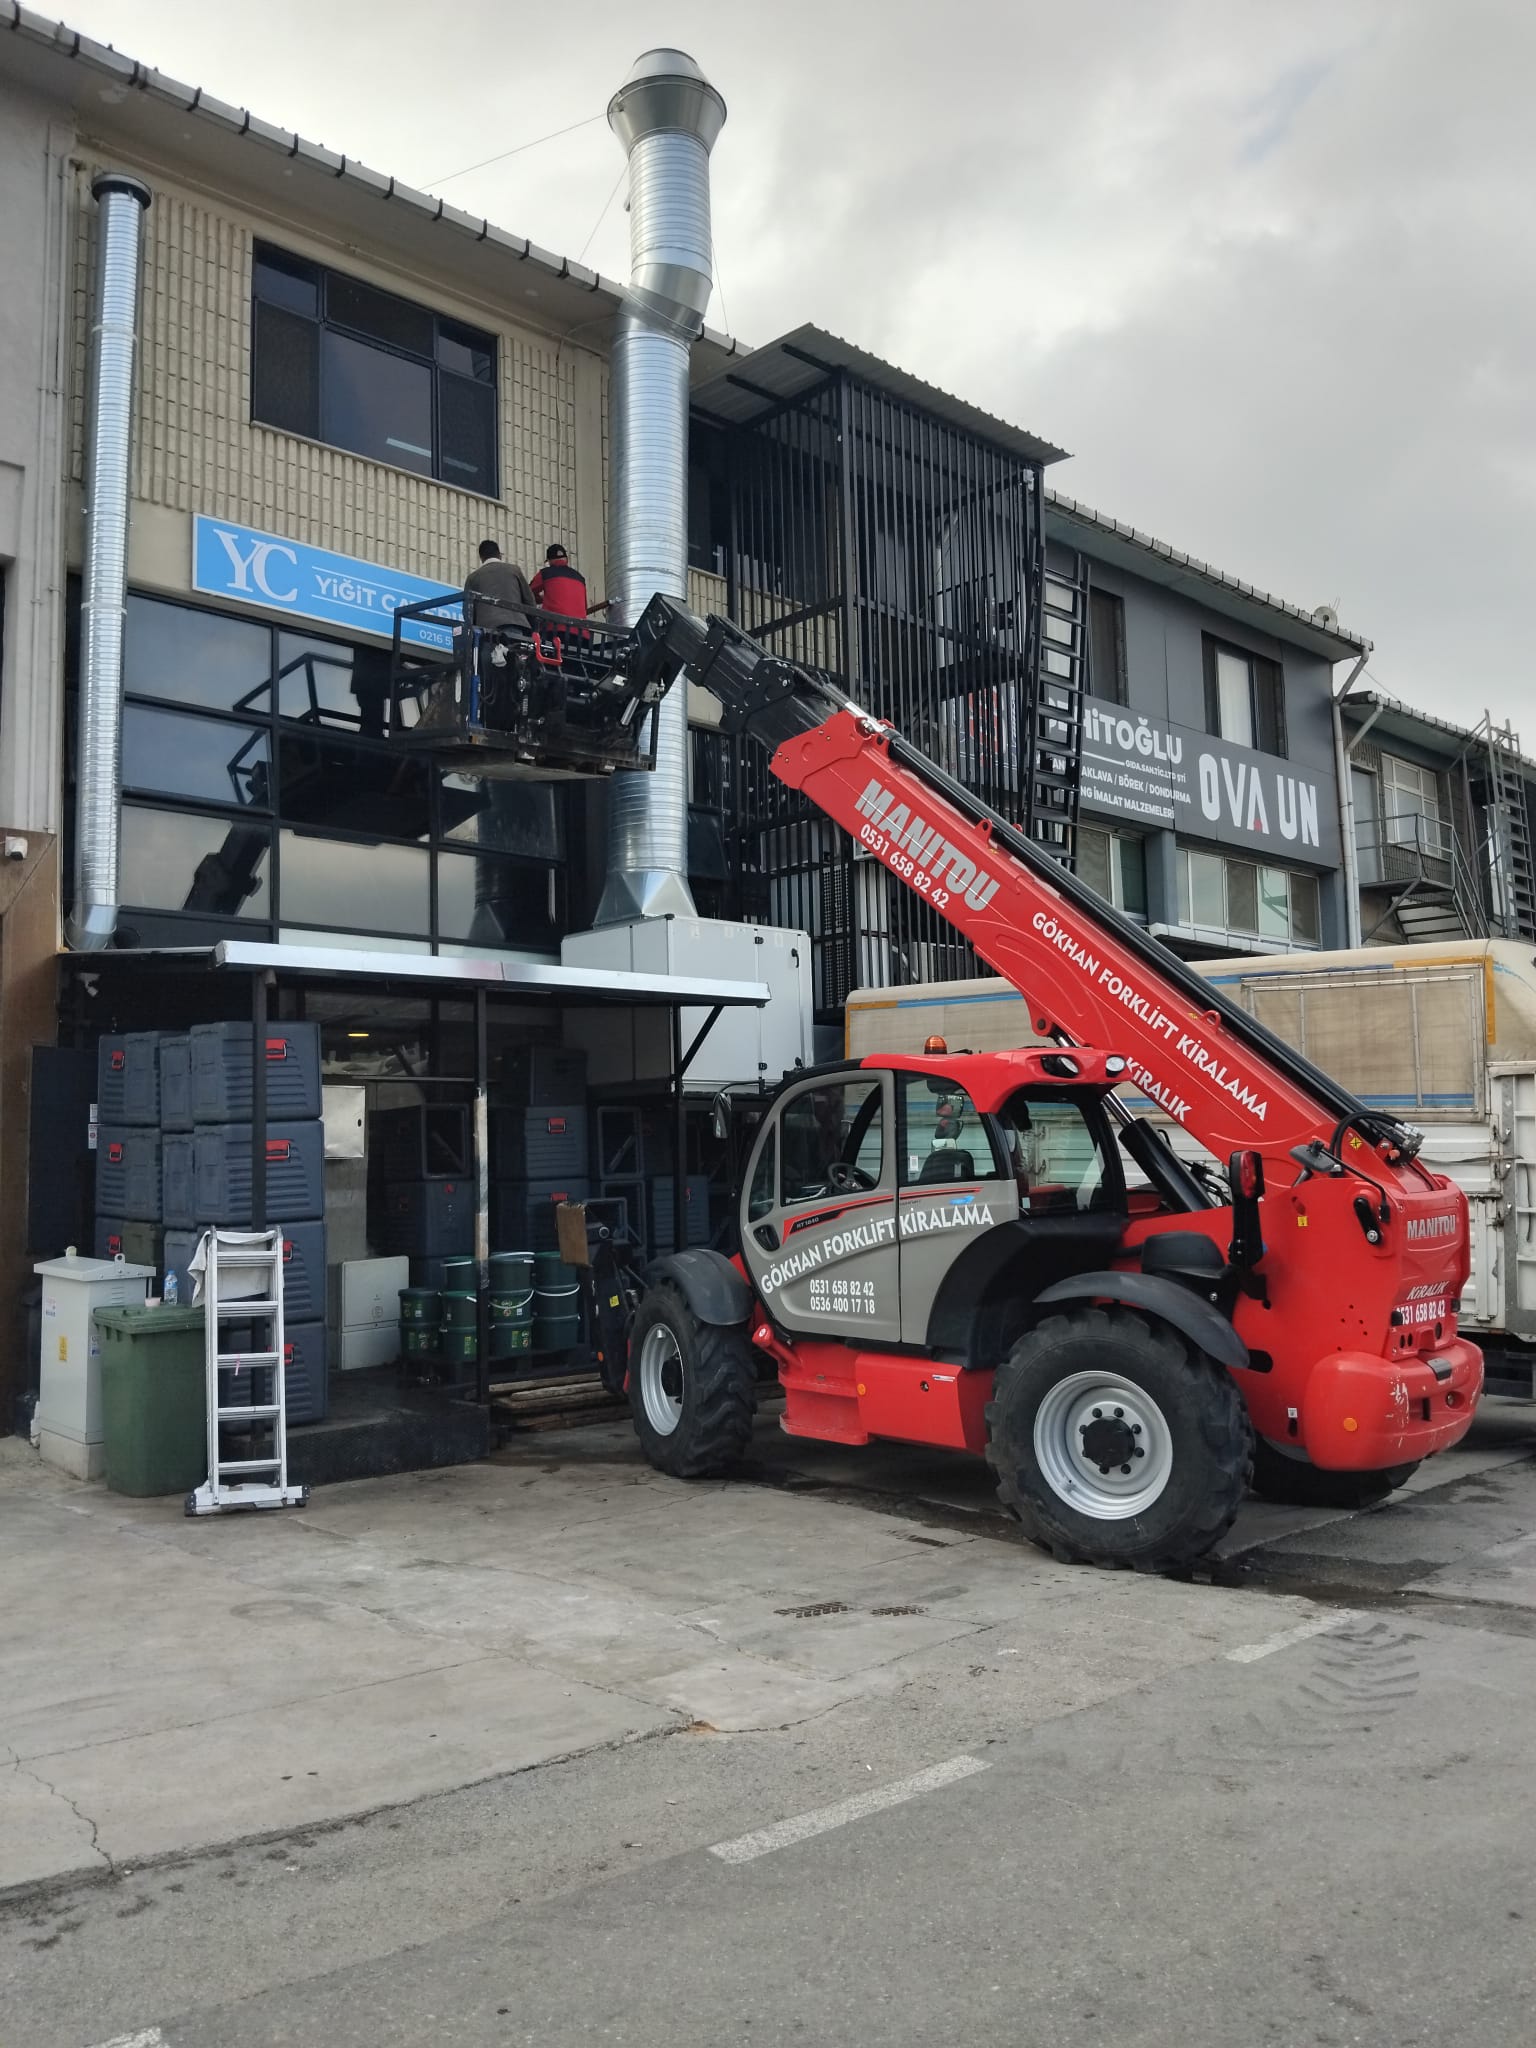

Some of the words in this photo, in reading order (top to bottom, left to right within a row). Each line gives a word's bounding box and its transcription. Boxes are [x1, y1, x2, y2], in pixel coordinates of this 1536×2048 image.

[212, 528, 298, 602] YC
[315, 574, 376, 607] YİĞİT
[420, 630, 443, 643] 0216
[1093, 786, 1123, 806] İMALAT
[1124, 798, 1175, 819] MALZEMELERİ
[1119, 774, 1144, 792] BÖREK
[1149, 783, 1191, 804] DONDURMA
[1198, 753, 1270, 835] OVA
[1276, 774, 1319, 847] UN
[854, 778, 1000, 911] MANITOU
[860, 823, 890, 856] 0531
[889, 851, 914, 877] 658
[913, 871, 932, 893] 82
[931, 888, 949, 909] 42
[1032, 912, 1100, 976] GÖKHAN
[1098, 968, 1179, 1039] FORKLİFT
[1175, 1034, 1267, 1122] KİRALAMA
[1407, 1214, 1456, 1240] MANITOU
[761, 1246, 823, 1294] GÖKHAN
[823, 1218, 896, 1260] FORKLİFT
[899, 1204, 994, 1236] KİRALAMA
[810, 1279, 829, 1294] 0531
[832, 1280, 848, 1295] 658
[850, 1281, 861, 1296] 82
[863, 1281, 875, 1297] 42
[810, 1296, 831, 1311] 0536
[833, 1297, 849, 1312] 400
[851, 1298, 862, 1313] 17
[864, 1299, 875, 1314] 18
[1415, 1303, 1428, 1322] 658
[1429, 1301, 1437, 1320] 82
[1437, 1299, 1446, 1317] 42
